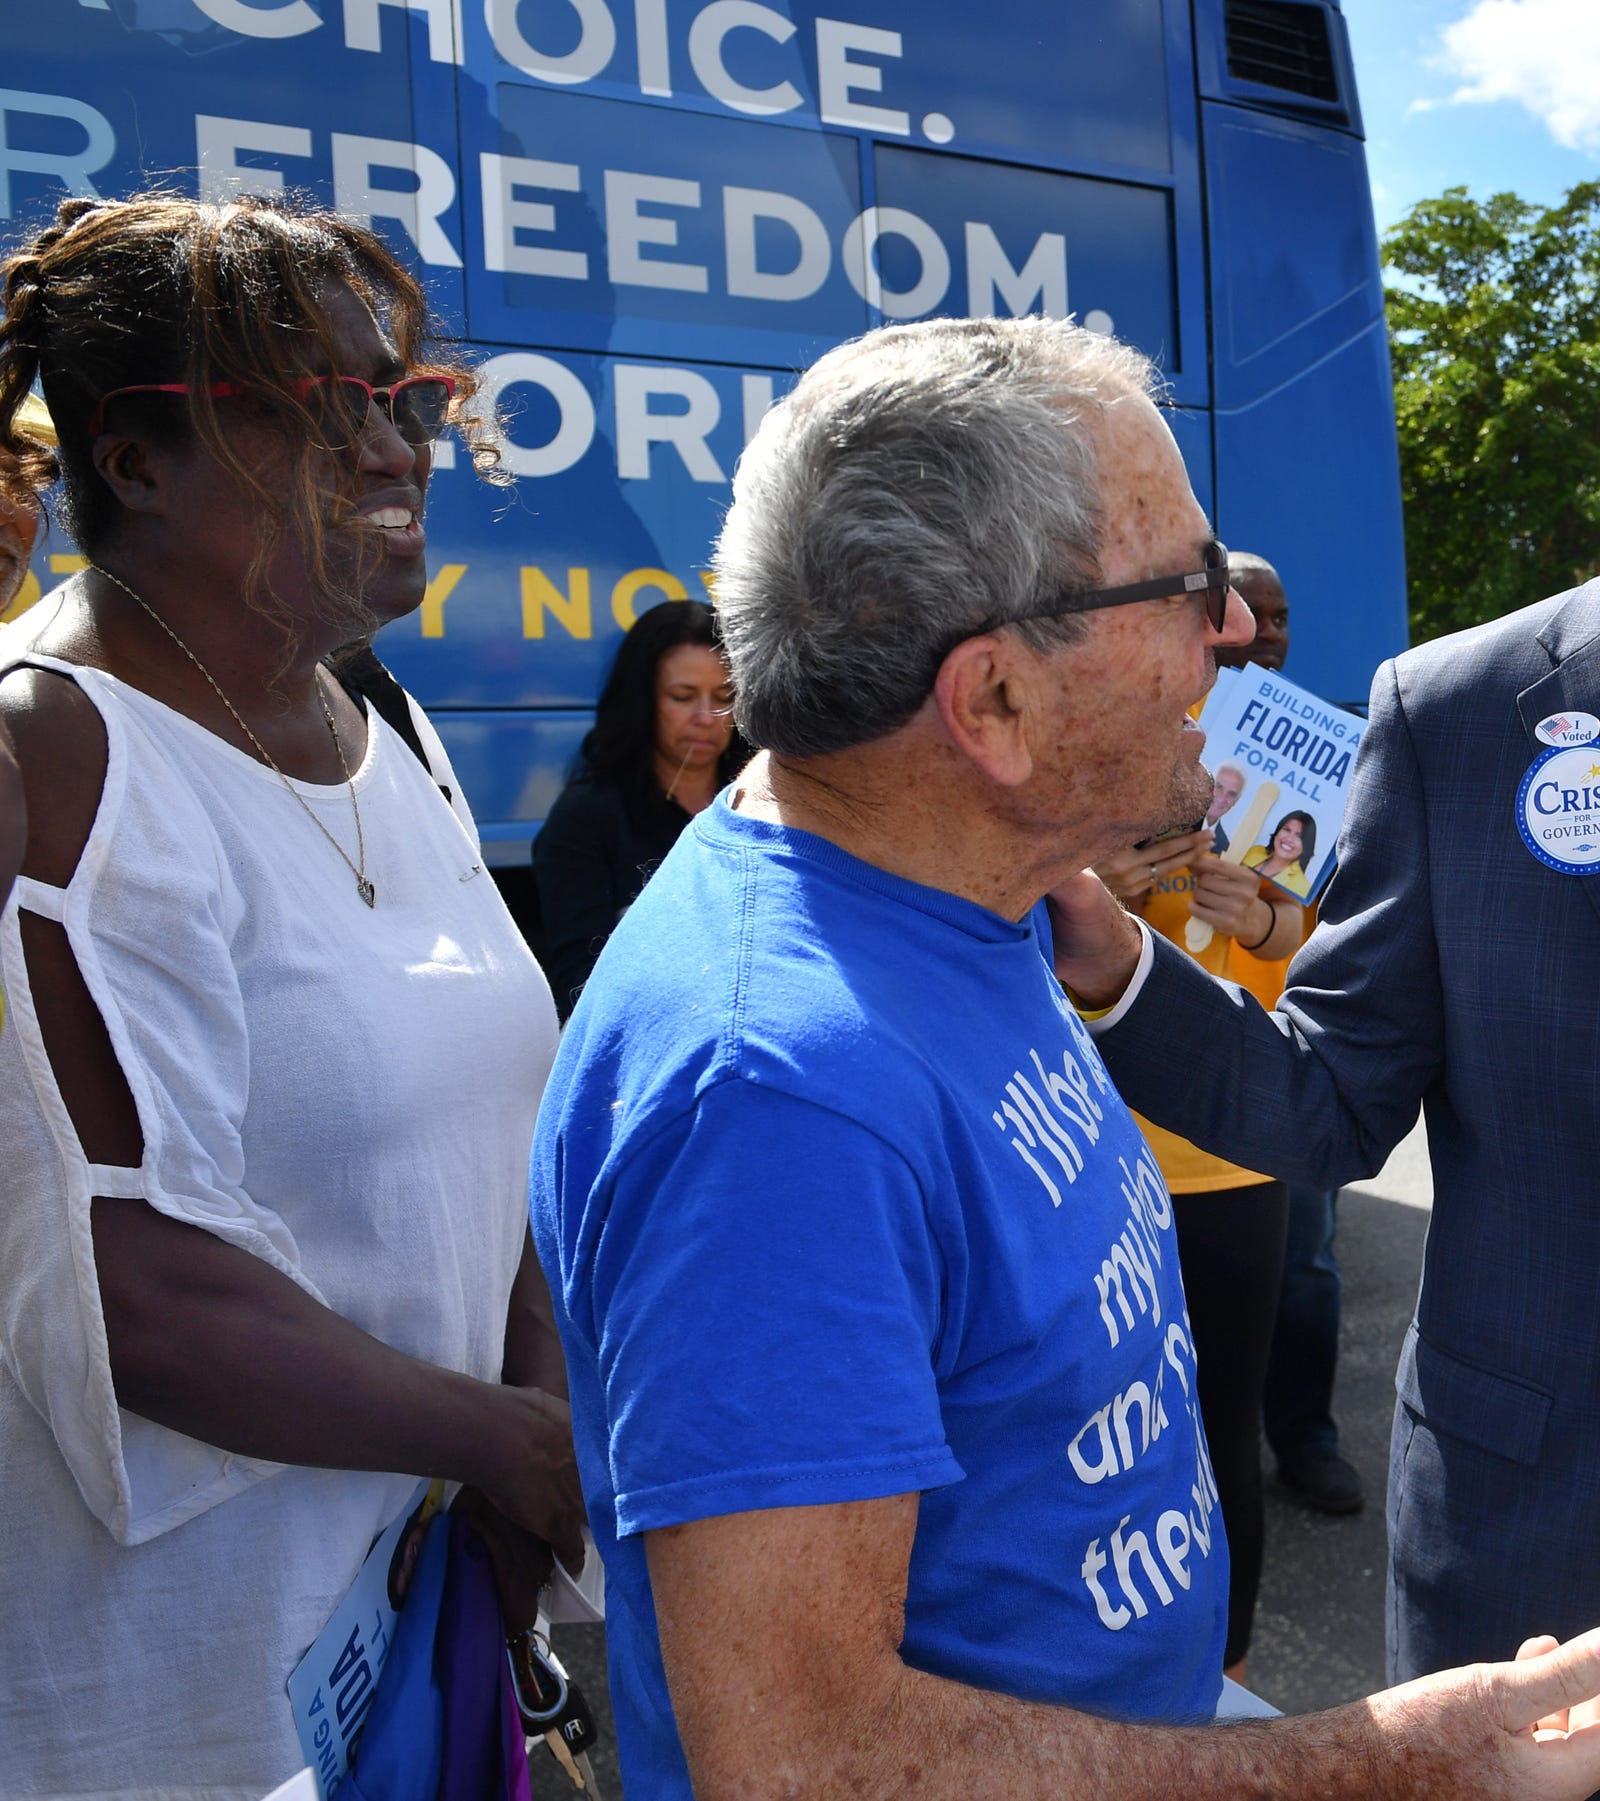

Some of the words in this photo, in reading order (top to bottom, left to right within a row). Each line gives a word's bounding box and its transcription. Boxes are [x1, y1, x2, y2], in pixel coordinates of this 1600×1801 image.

[195, 114, 1115, 336] FREEDOM.
[1236, 699, 1352, 787] FLORIDA
[1258, 681, 1347, 739] BUILDING
[1562, 731, 1592, 742] Voted
[1233, 741, 1279, 777] FOR
[1281, 770, 1322, 804] ALL
[1574, 814, 1592, 823] FOR
[1029, 1048, 1104, 1147] be
[1093, 1217, 1161, 1349] my
